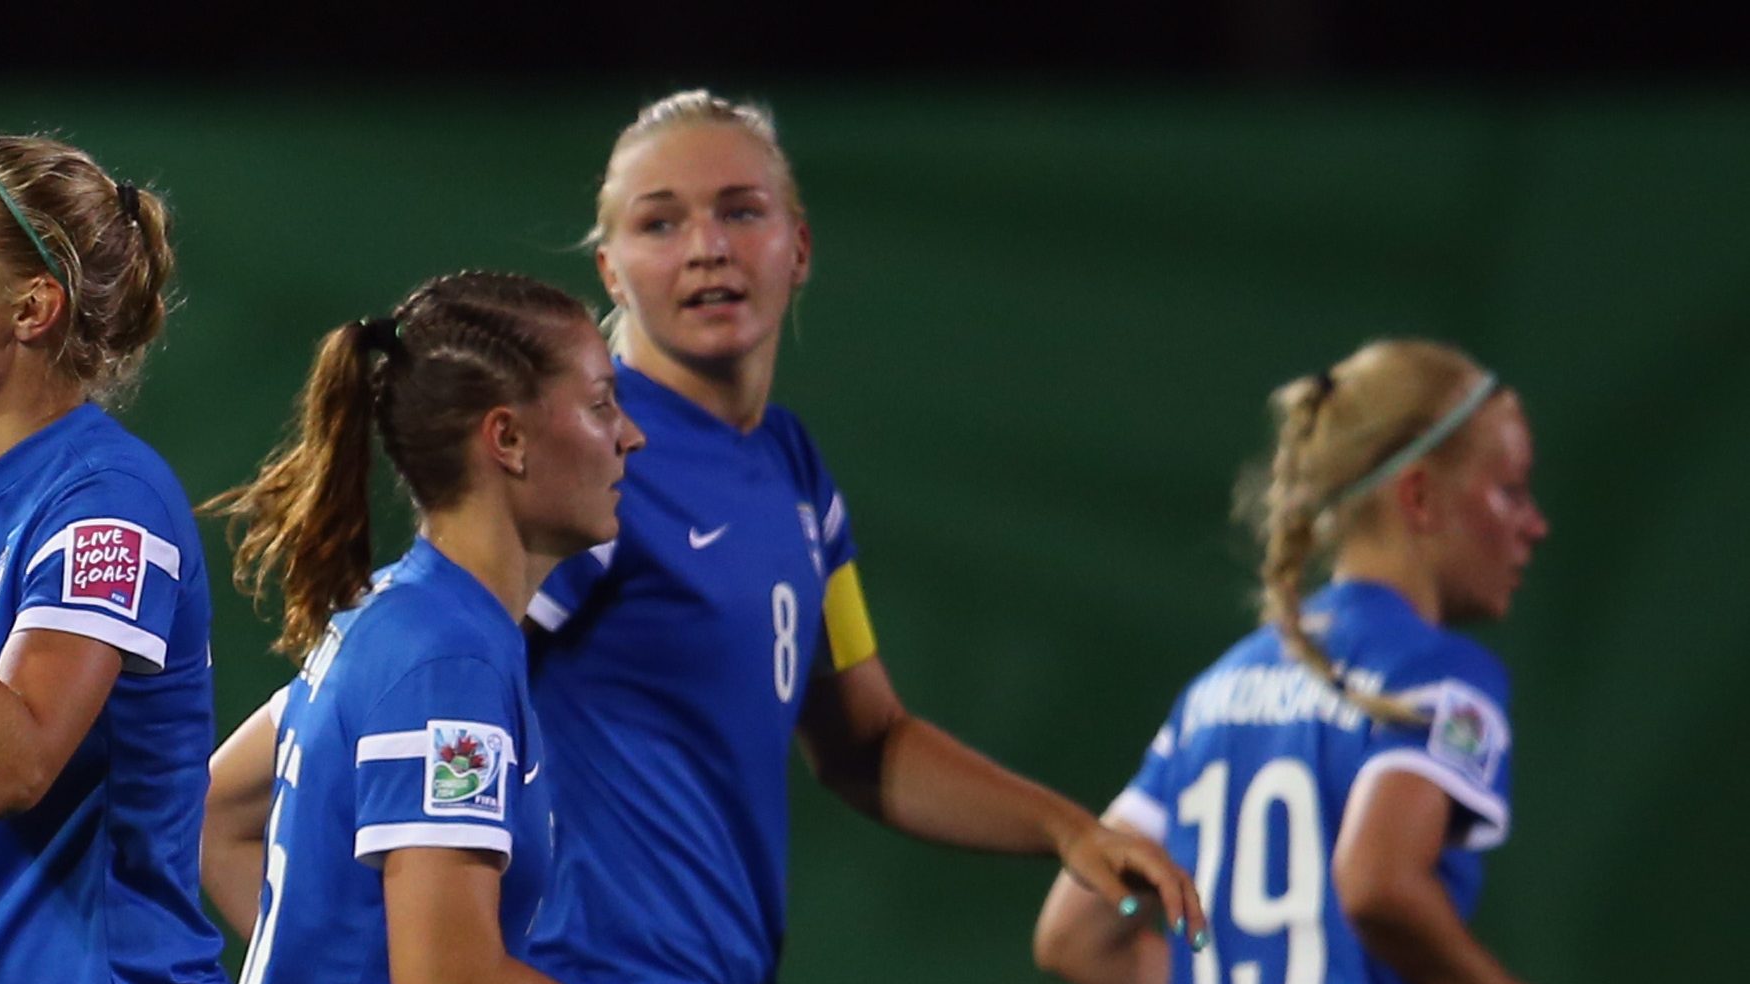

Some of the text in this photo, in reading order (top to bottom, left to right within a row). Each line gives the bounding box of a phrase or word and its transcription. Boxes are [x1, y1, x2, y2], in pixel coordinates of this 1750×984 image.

[76, 528, 123, 549] LIVE
[75, 546, 134, 569] YOUR
[74, 565, 137, 589] GOALS
[771, 581, 798, 703] 8
